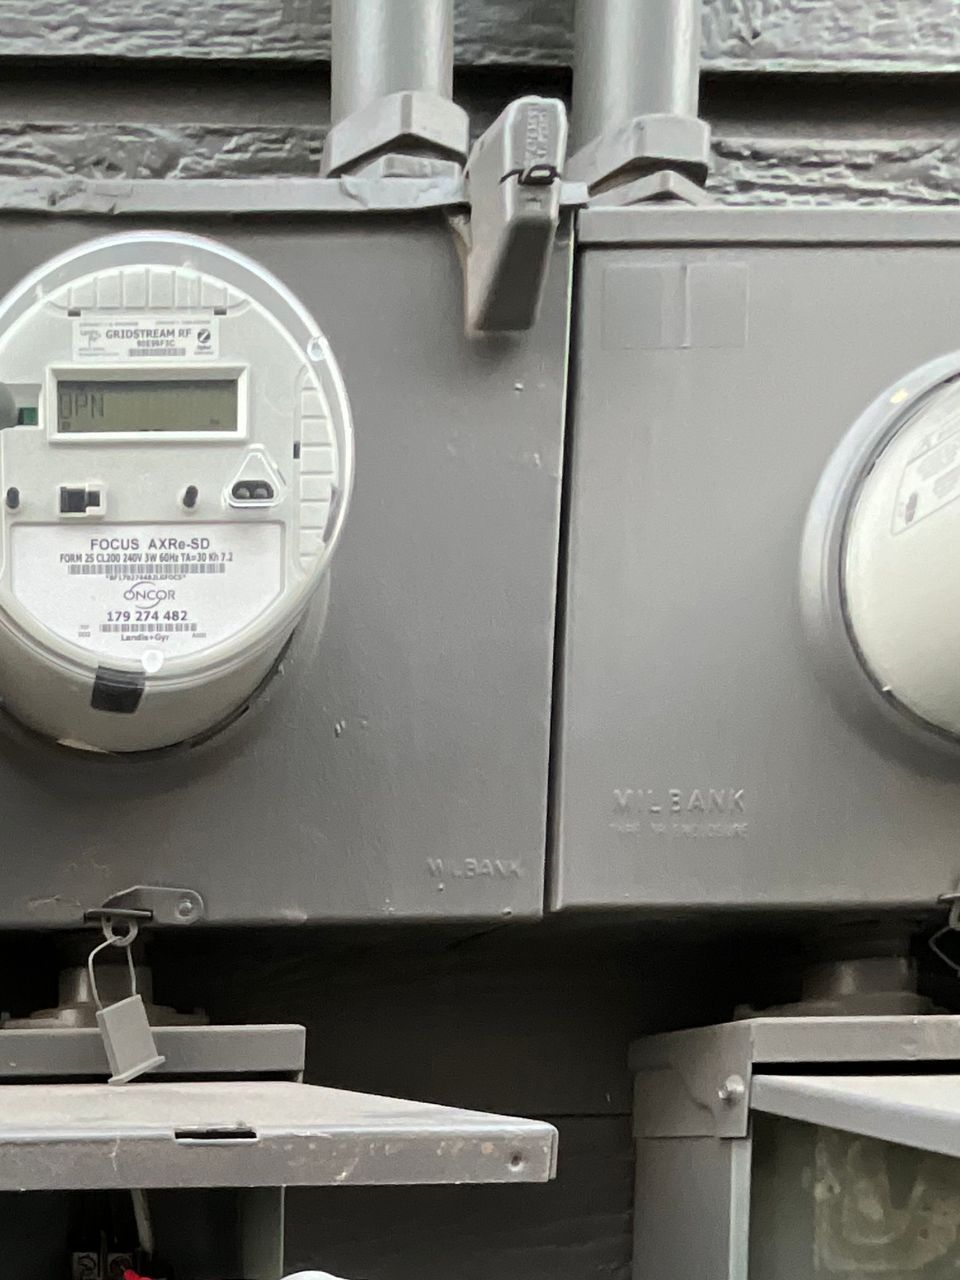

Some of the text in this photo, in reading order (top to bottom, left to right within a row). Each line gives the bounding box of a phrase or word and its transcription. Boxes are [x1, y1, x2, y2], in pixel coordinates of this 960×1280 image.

[106, 329, 176, 339] GRIDSTREAM
[90, 537, 210, 550] FOCUS AXRe-SD
[60, 553, 83, 563] FORM
[96, 553, 121, 563] CL200
[123, 553, 142, 563] 240V
[123, 590, 176, 601] ONCOR
[106, 610, 188, 622] 179 274 482
